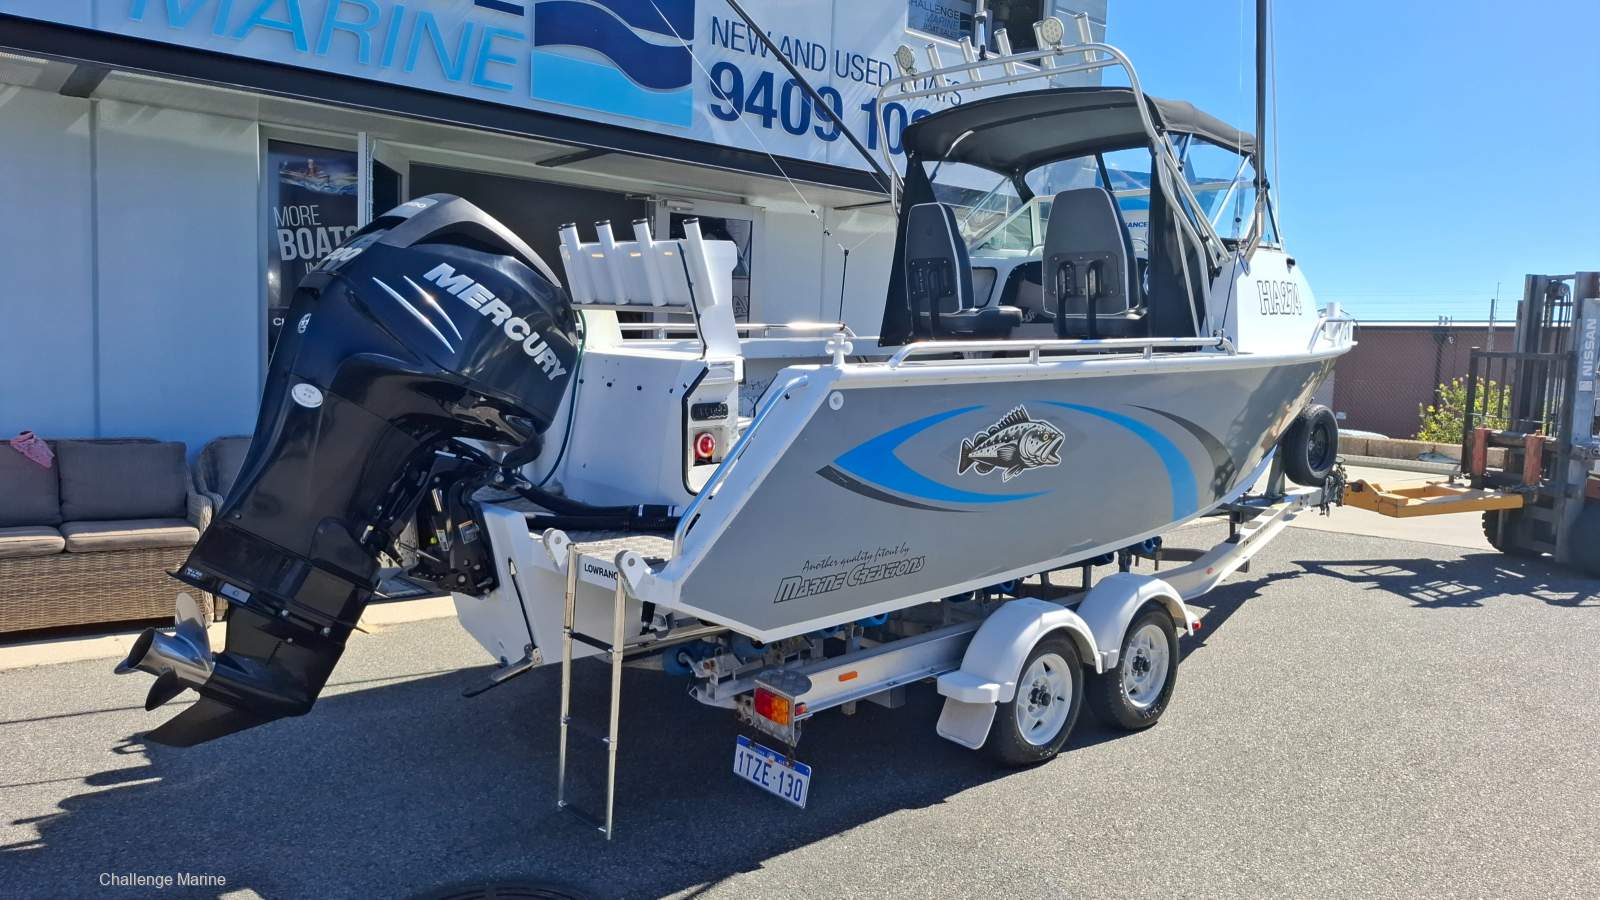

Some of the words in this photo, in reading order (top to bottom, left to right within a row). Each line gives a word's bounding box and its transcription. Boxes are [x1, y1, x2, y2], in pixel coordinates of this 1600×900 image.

[711, 16, 772, 58] NEW
[780, 36, 827, 72] AND
[836, 50, 893, 88] USED
[709, 61, 844, 142] 9409
[273, 205, 321, 227] MORE
[423, 262, 567, 381] MERCURY
[1582, 318, 1597, 377] NISSAN
[584, 563, 619, 581] LOWRANC
[801, 555, 838, 573] Another
[840, 550, 873, 568] quality
